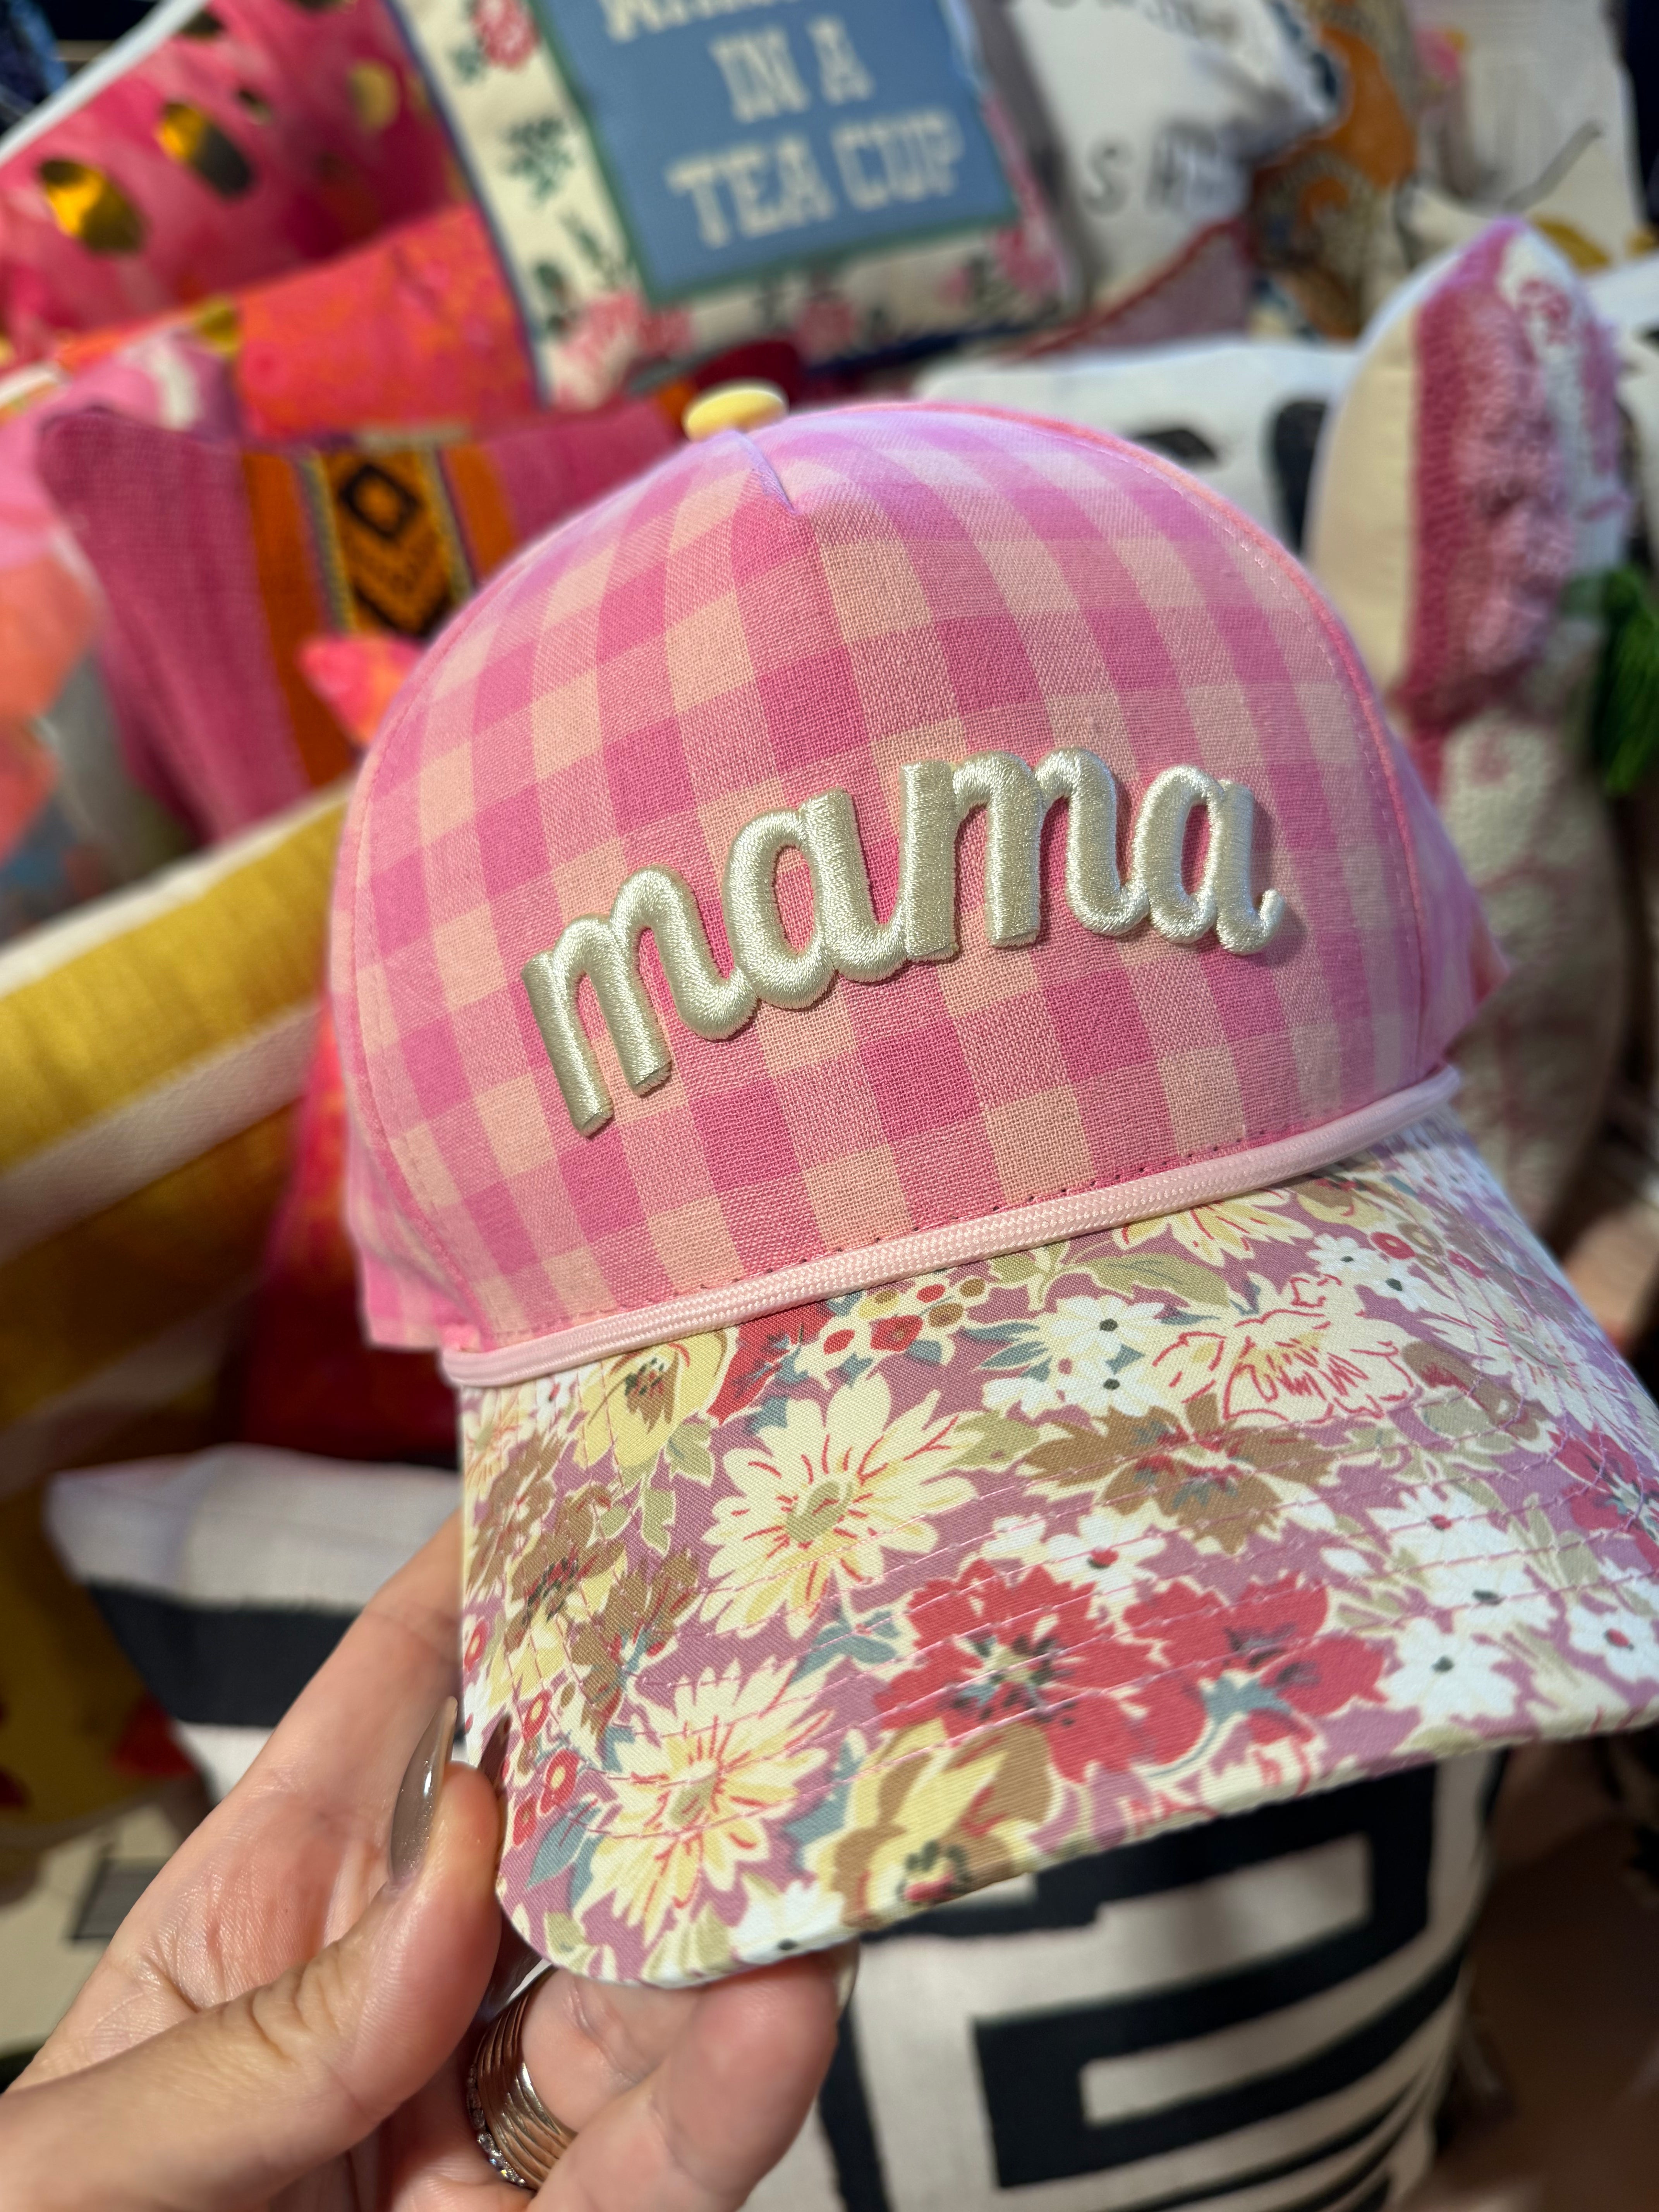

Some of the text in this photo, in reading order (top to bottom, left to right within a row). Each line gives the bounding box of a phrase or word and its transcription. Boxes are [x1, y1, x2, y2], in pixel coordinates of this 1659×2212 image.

[711, 27, 808, 122] IN
[809, 17, 873, 105] A
[666, 136, 834, 247] TEA
[833, 108, 962, 210] CUP
[522, 746, 1284, 1138] mama
